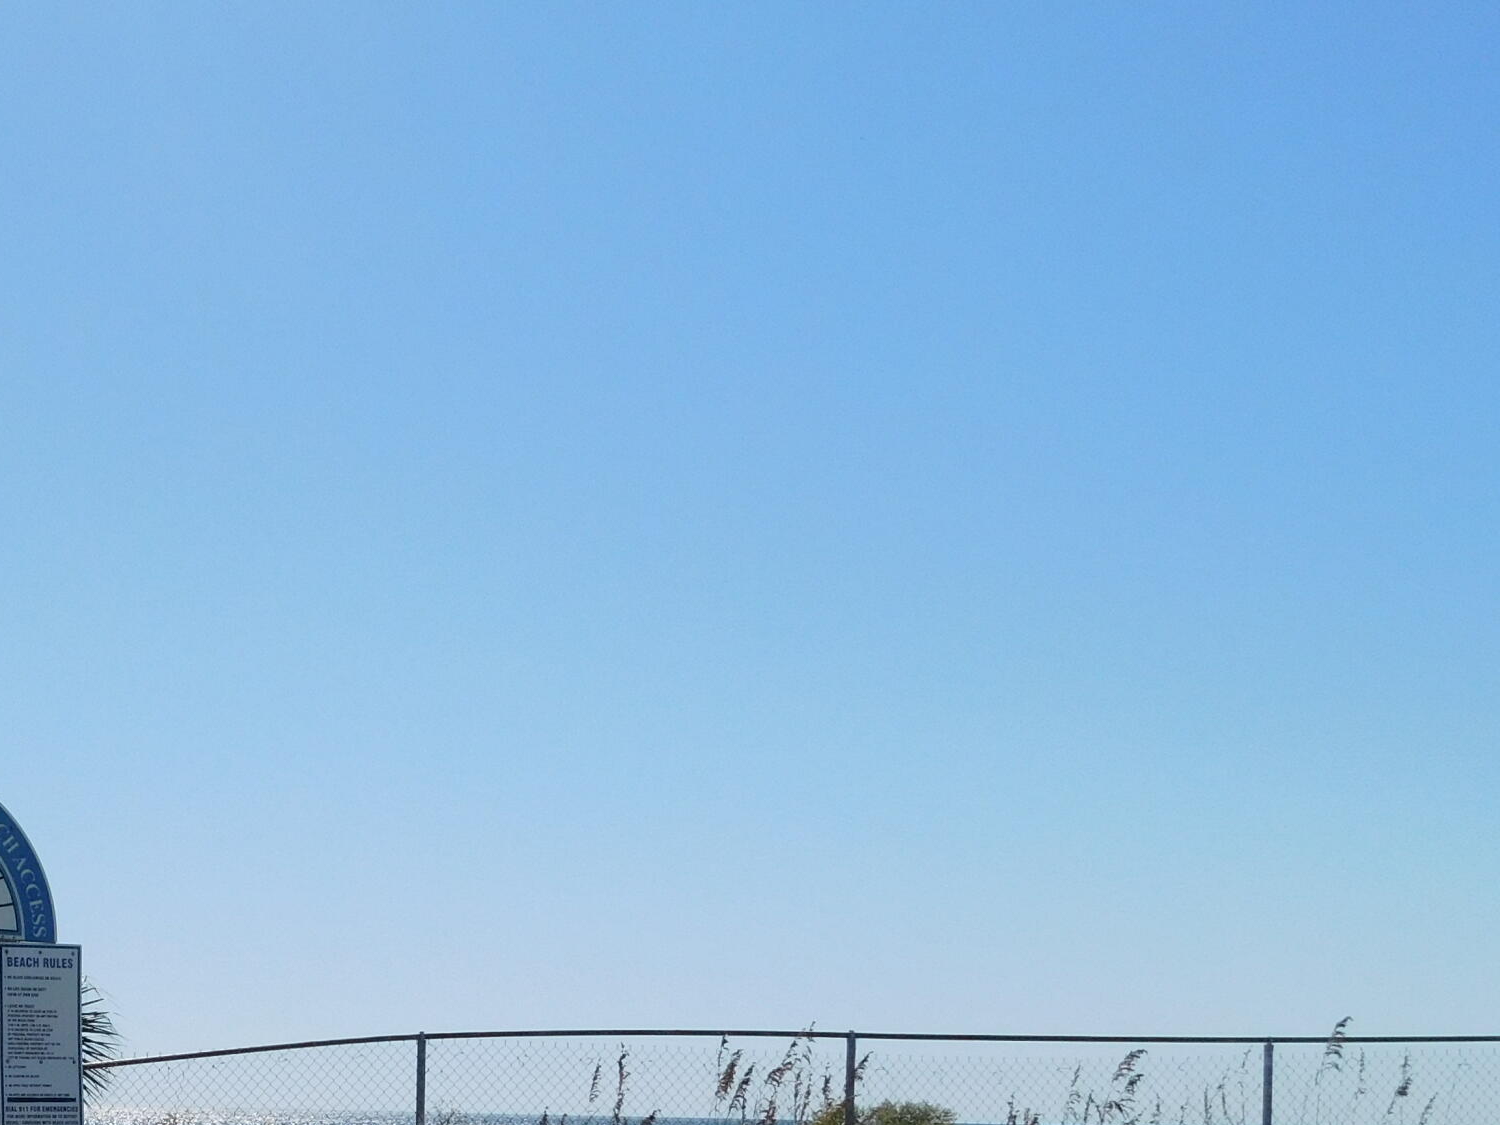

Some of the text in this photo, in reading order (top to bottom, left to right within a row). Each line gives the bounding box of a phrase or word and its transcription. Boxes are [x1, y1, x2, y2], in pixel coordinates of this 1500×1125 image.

[12, 857, 47, 938] ACCESS
[7, 957, 73, 969] BEACH RULES
